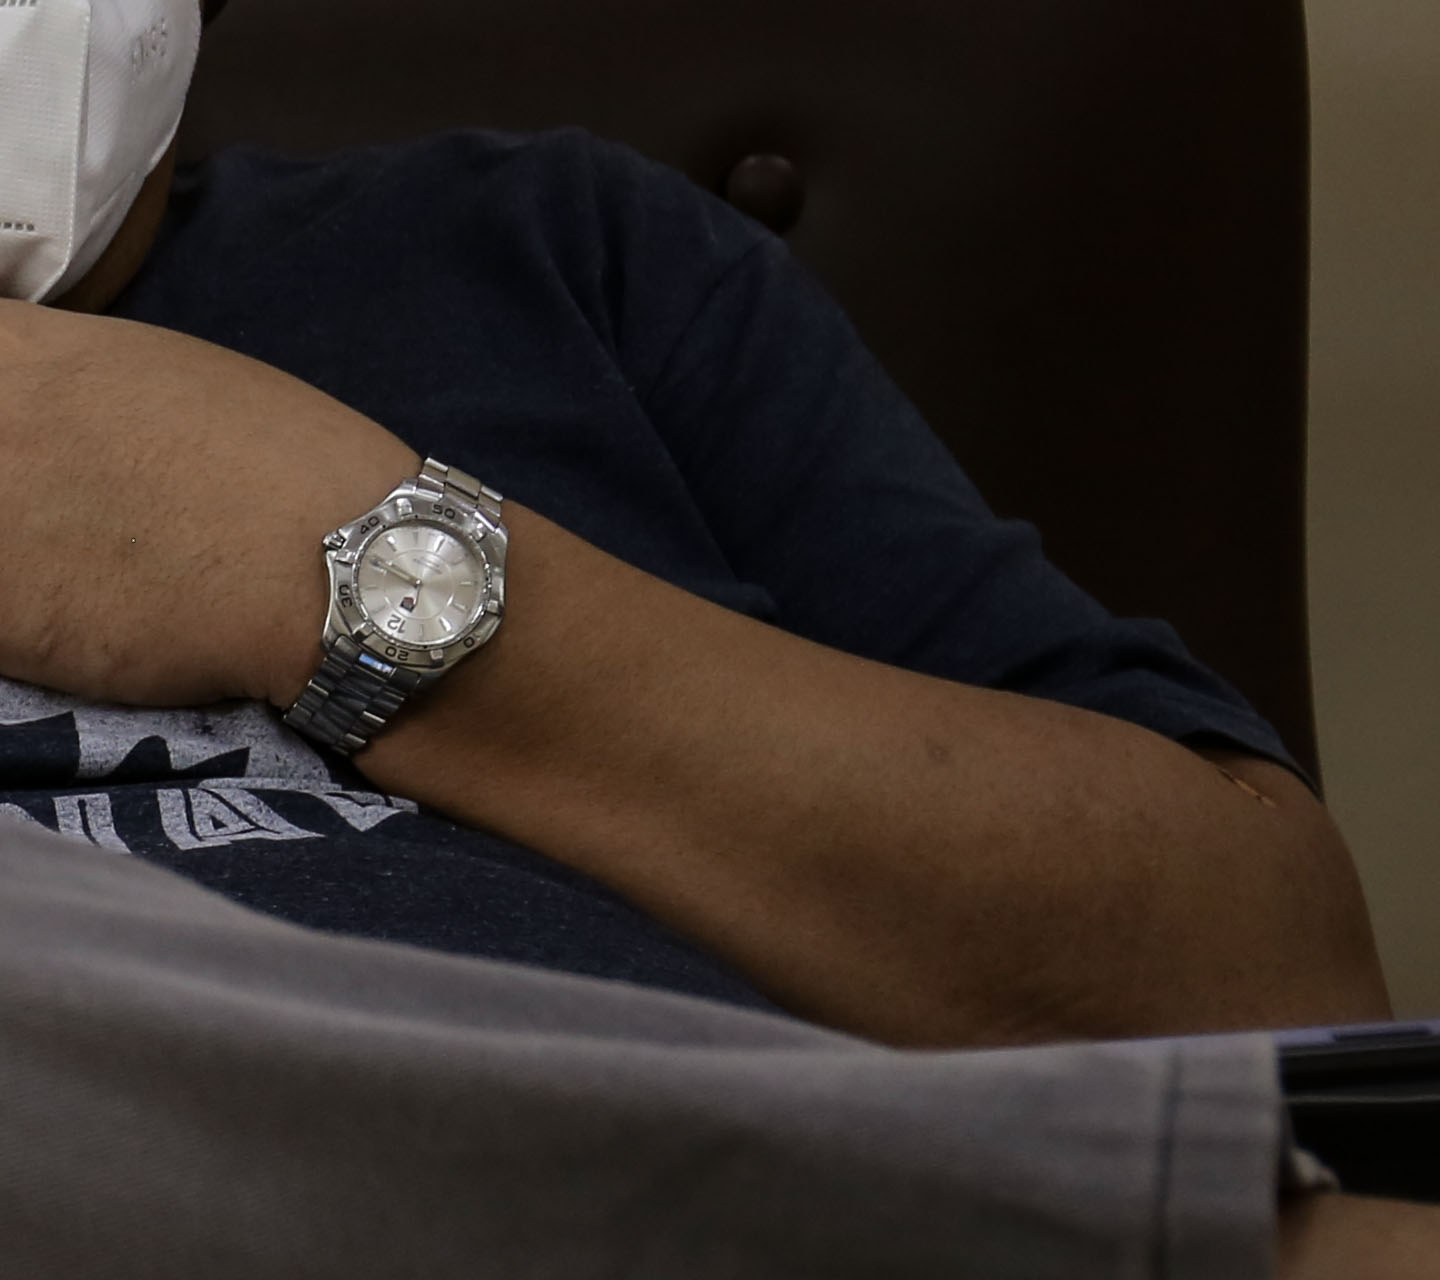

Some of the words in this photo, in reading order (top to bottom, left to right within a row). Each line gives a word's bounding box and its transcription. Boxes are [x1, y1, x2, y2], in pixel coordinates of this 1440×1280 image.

[432, 504, 456, 520] 50
[359, 515, 379, 535] 40
[384, 646, 409, 662] 20
